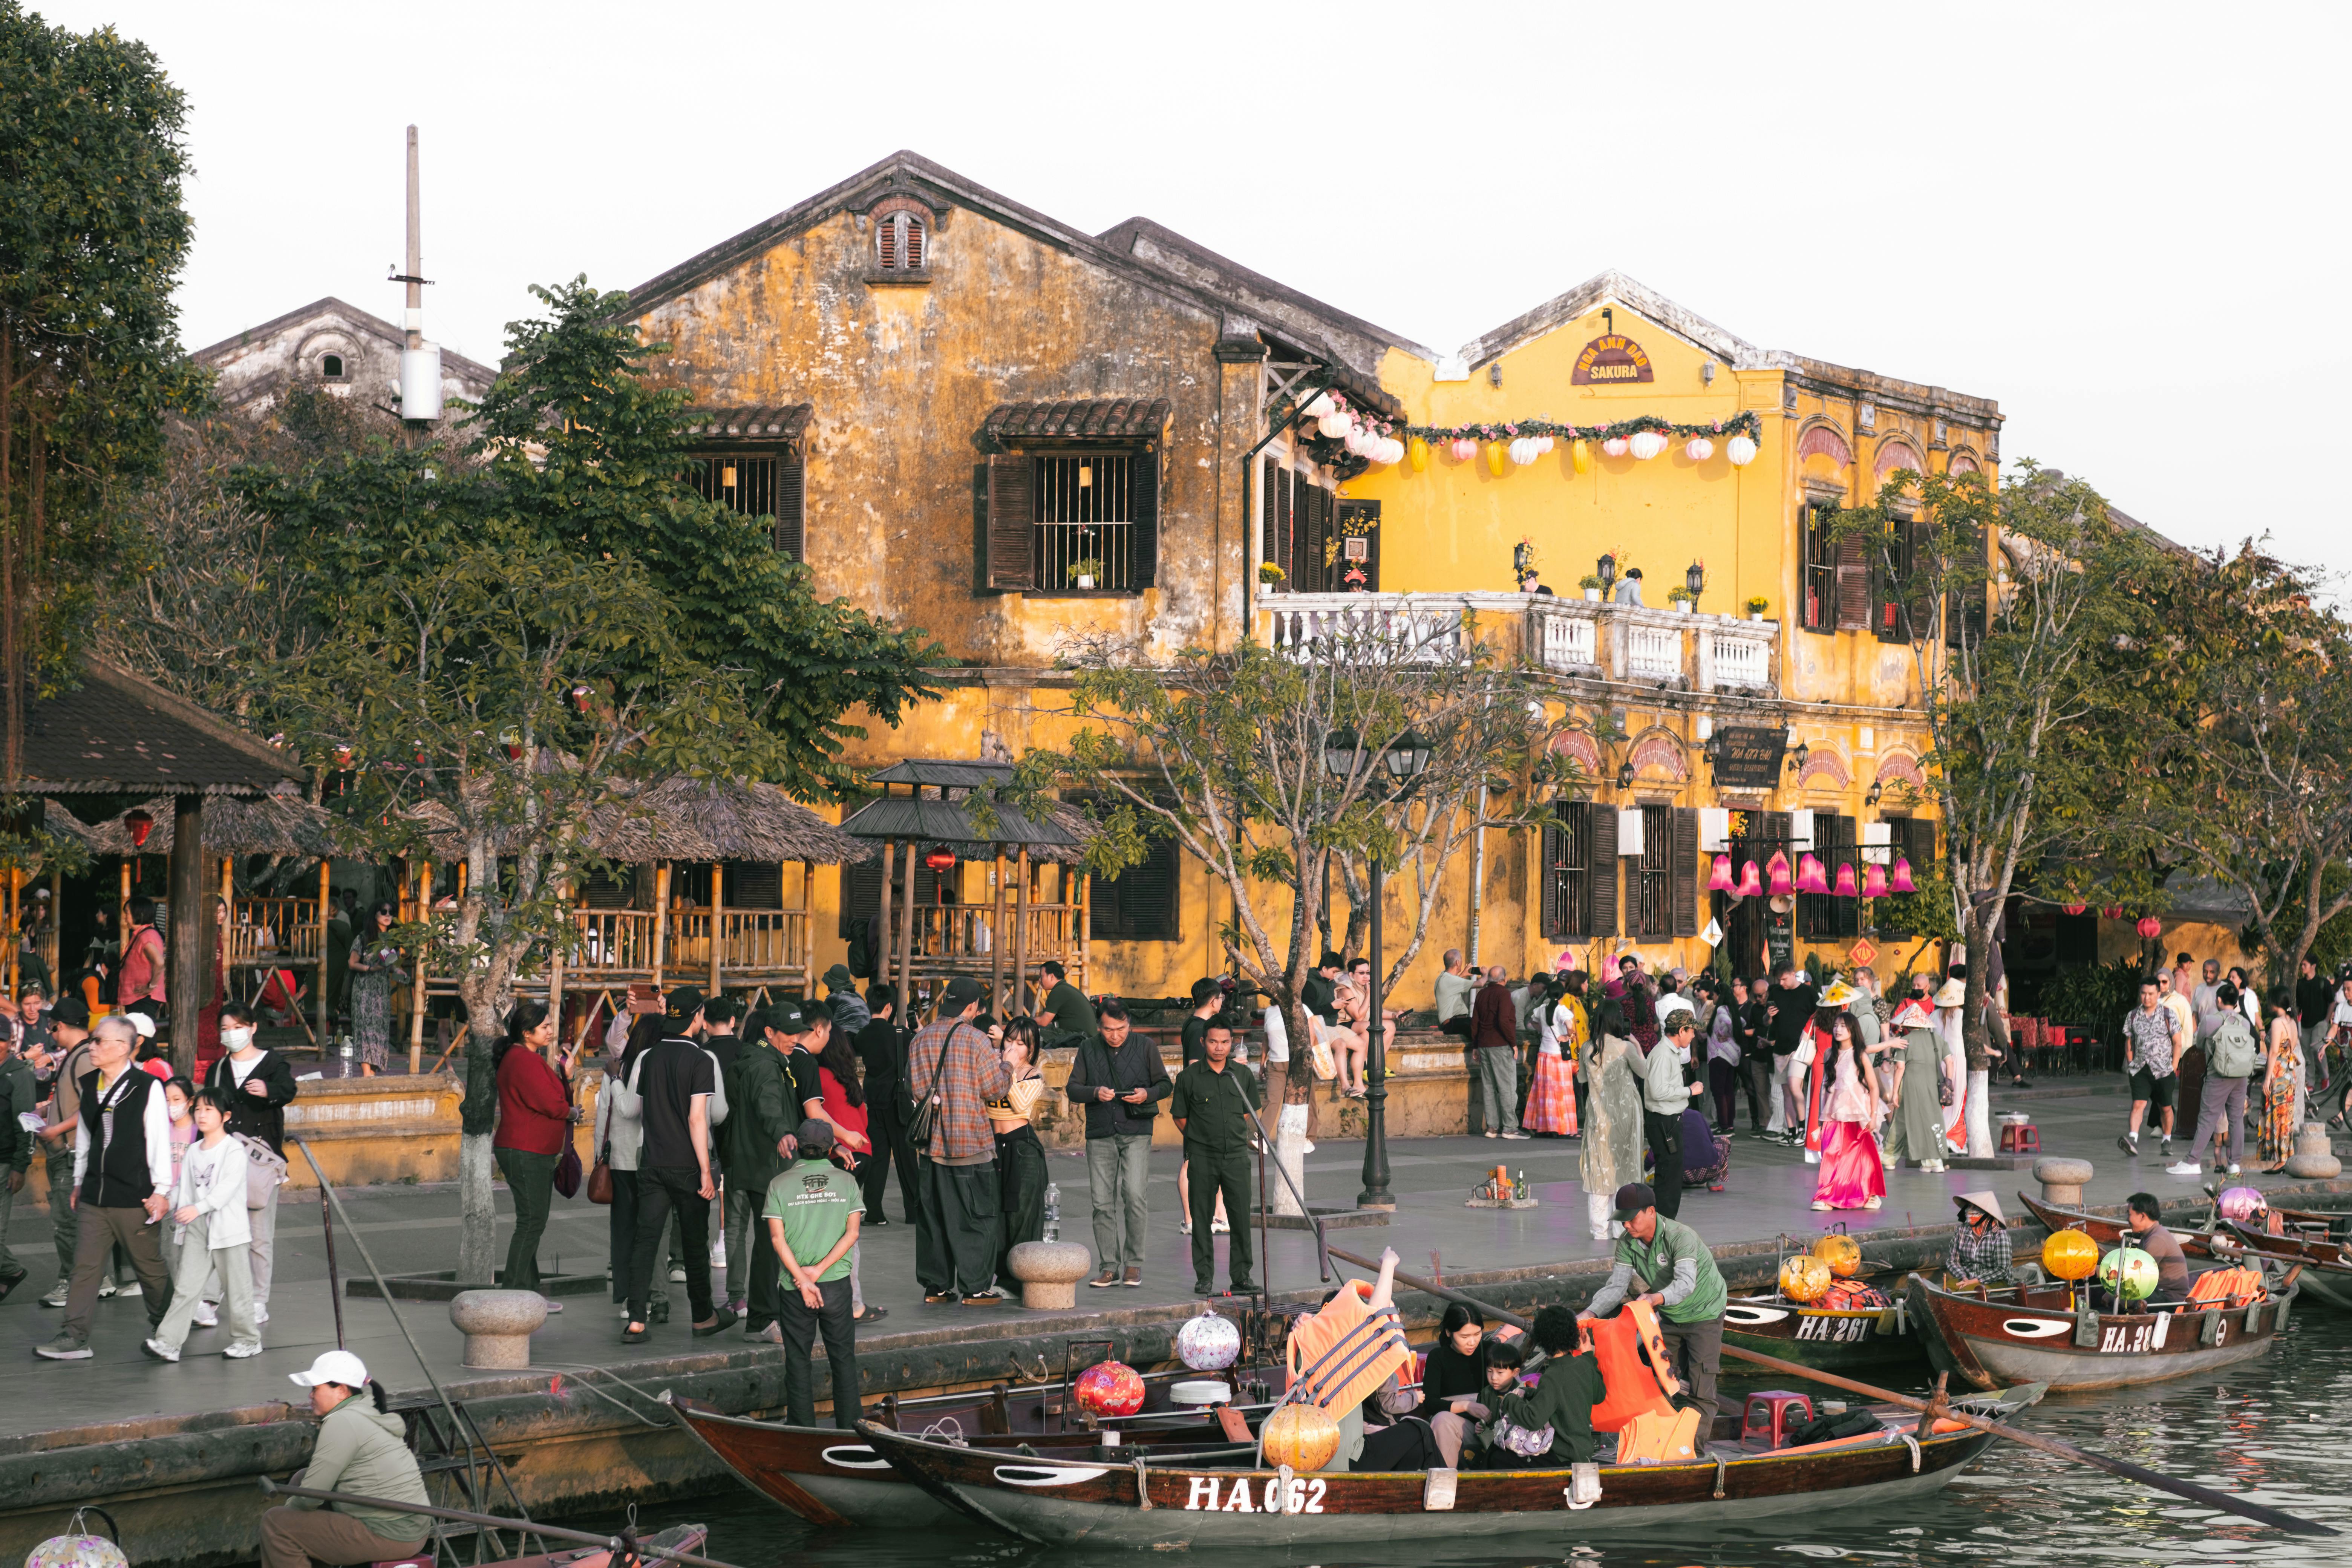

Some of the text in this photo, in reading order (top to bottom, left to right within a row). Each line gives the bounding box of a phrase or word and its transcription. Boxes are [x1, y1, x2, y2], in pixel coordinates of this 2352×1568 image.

[1578, 348, 1599, 371] HOA
[1599, 337, 1626, 352] ANH
[1591, 365, 1637, 379] SAKURA
[1795, 1316, 1869, 1342] HA 261
[2100, 1325, 2159, 1352] HA.28
[1185, 1477, 1326, 1513] HA.062
